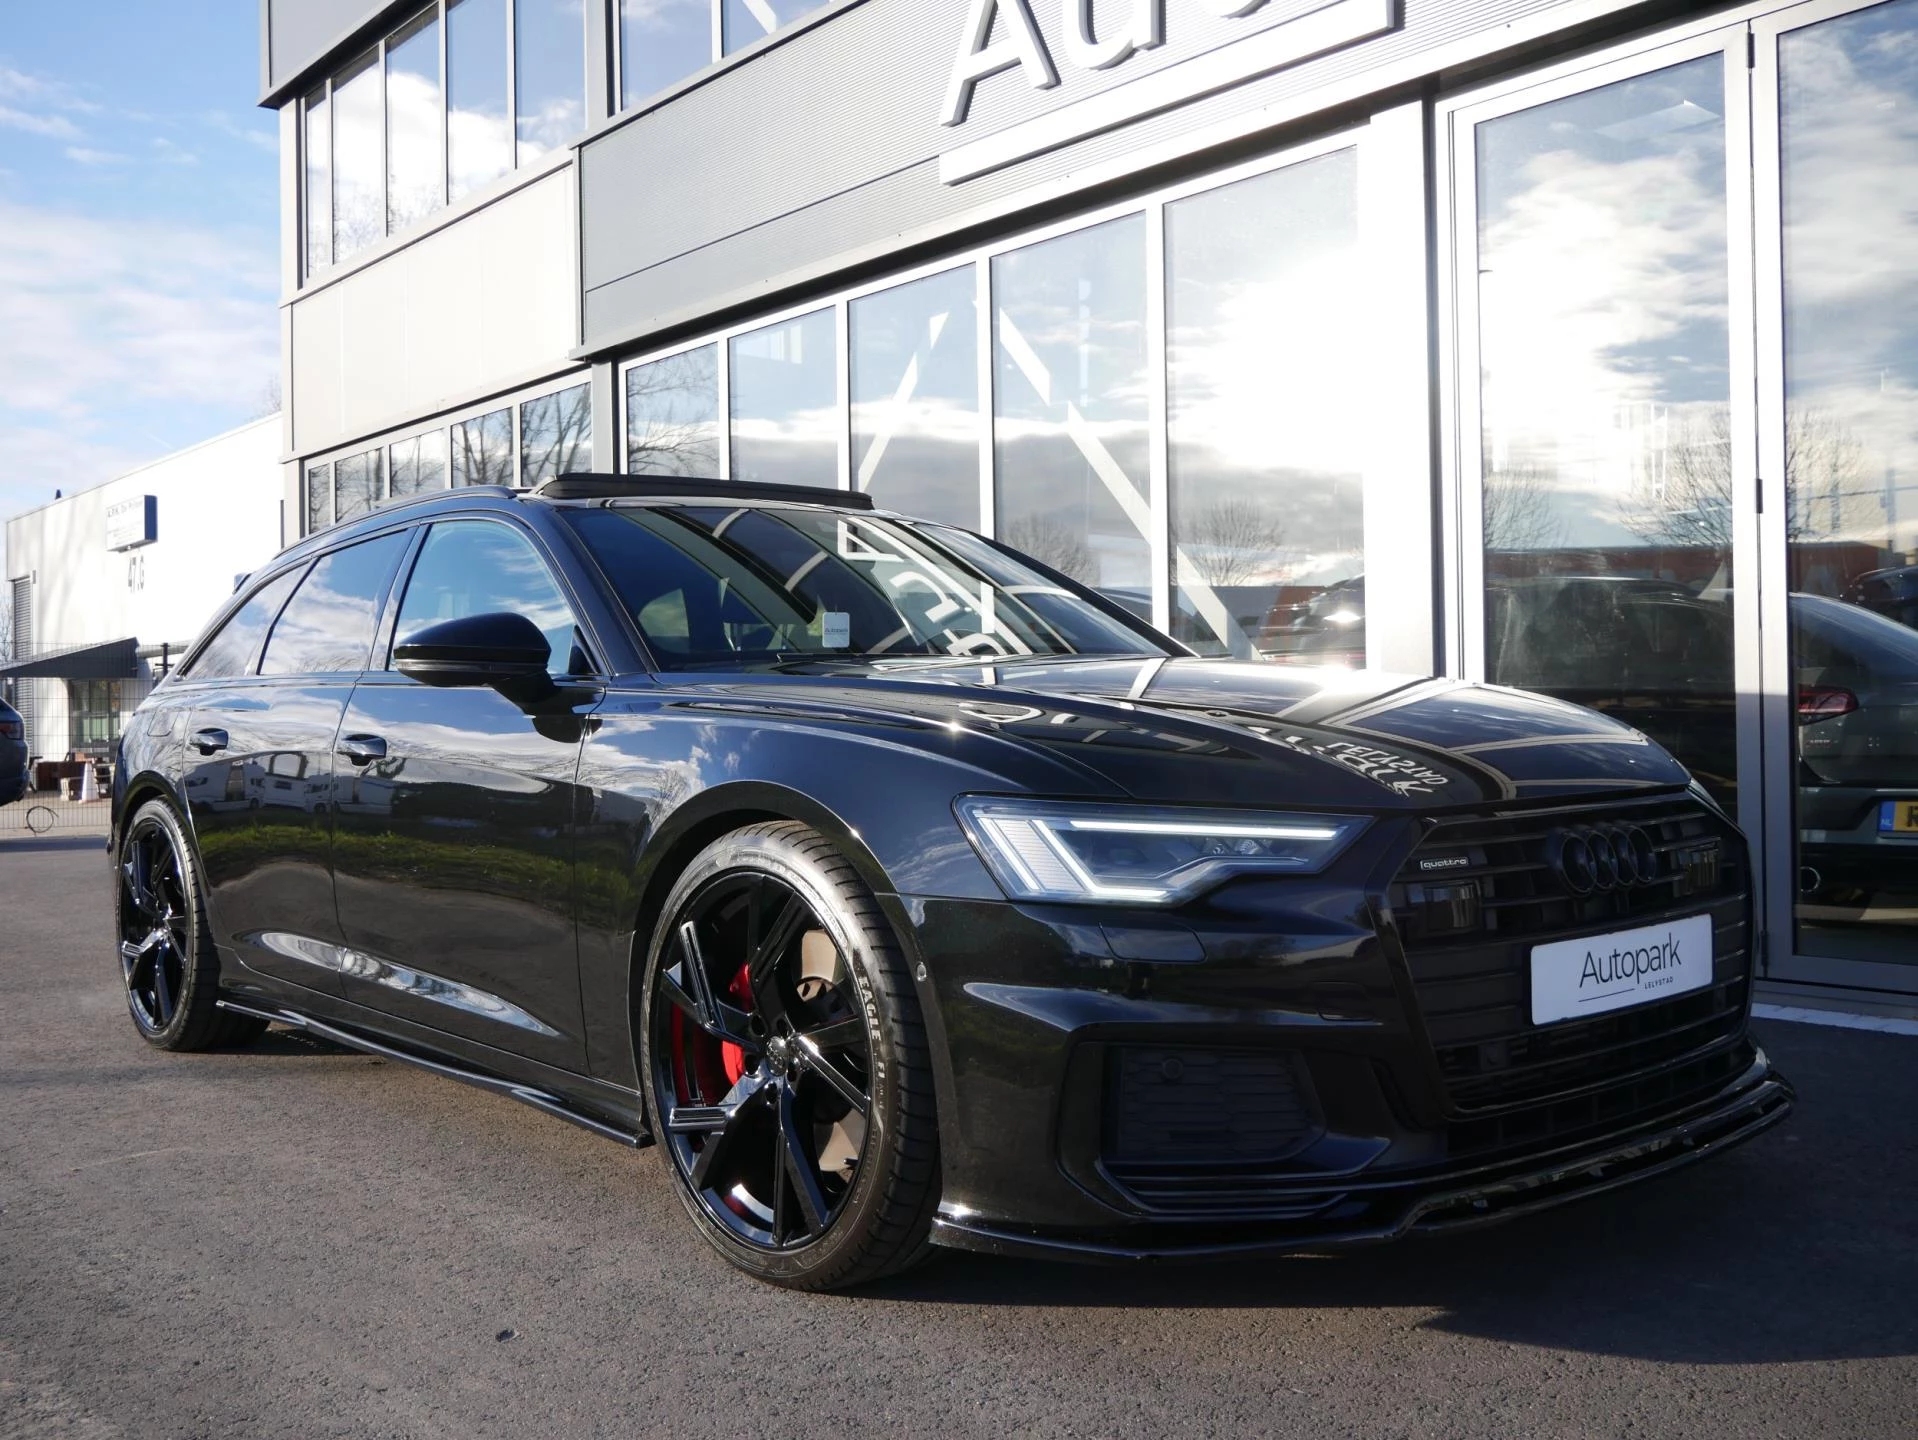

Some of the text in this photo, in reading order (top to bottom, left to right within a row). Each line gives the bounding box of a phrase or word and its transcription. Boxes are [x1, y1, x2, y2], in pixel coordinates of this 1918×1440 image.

[1422, 859, 1467, 869] quattro
[1579, 932, 1682, 988] Autopark
[1644, 976, 1675, 989] LELYSTAD
[859, 976, 881, 1041] EAGLE
